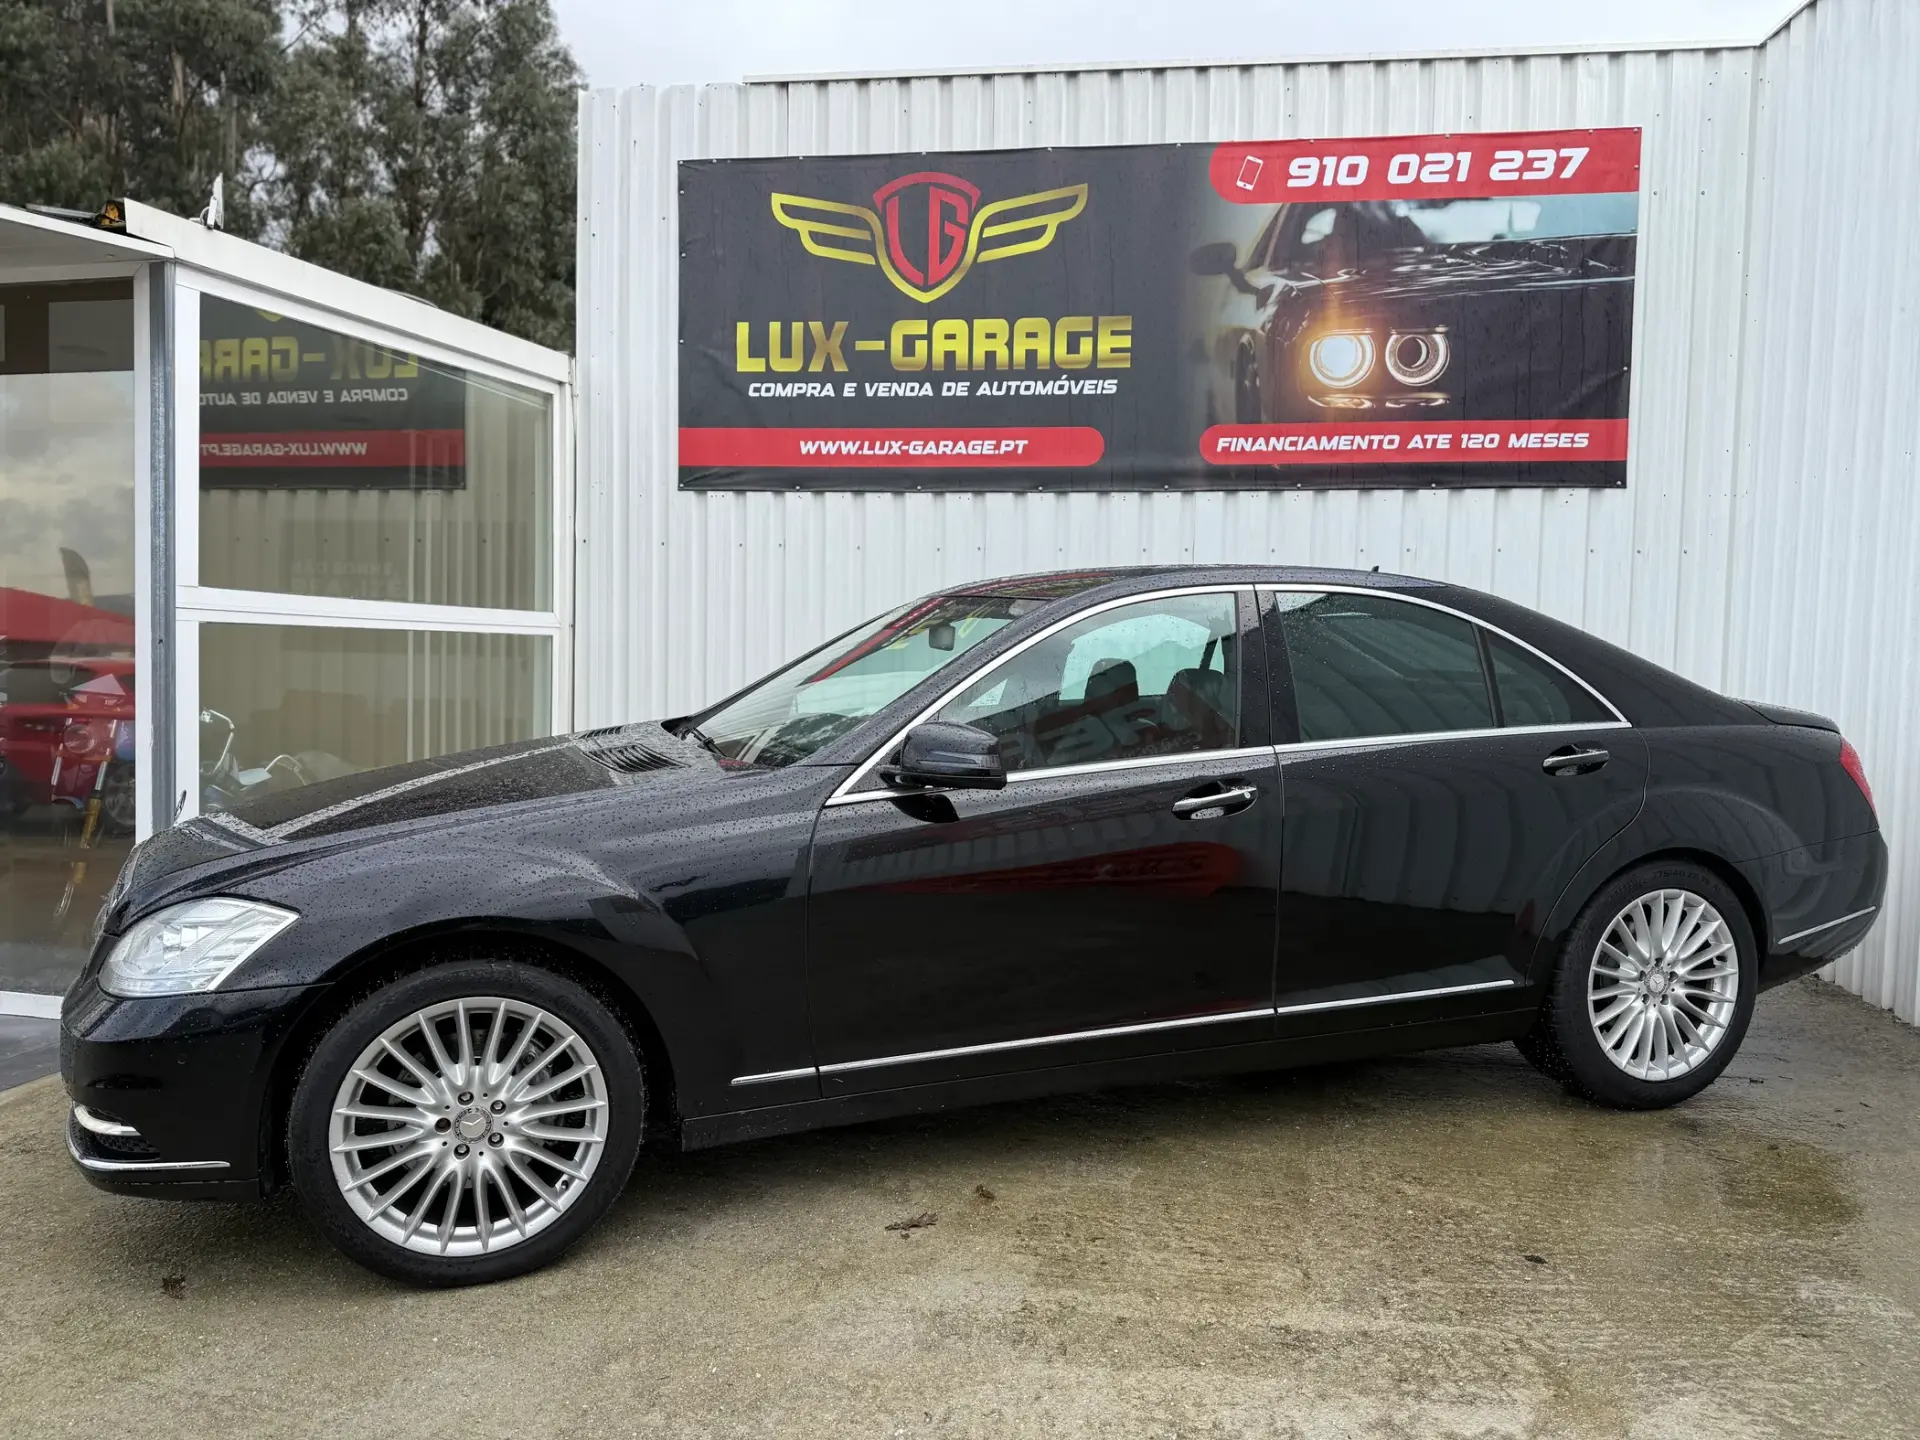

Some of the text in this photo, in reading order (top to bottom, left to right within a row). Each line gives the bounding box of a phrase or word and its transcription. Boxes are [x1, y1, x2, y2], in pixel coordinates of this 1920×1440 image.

[1287, 147, 1590, 187] 910 021 237
[736, 316, 1132, 373] LUX-GARAGE
[748, 375, 1118, 398] COMPRA E VENDA DE AUTOMÓVEIS
[799, 440, 1029, 455] WWW.LUX-GARAGE.PT
[1216, 432, 1590, 453] FINANCIAMENTO ATE 120 MESES
